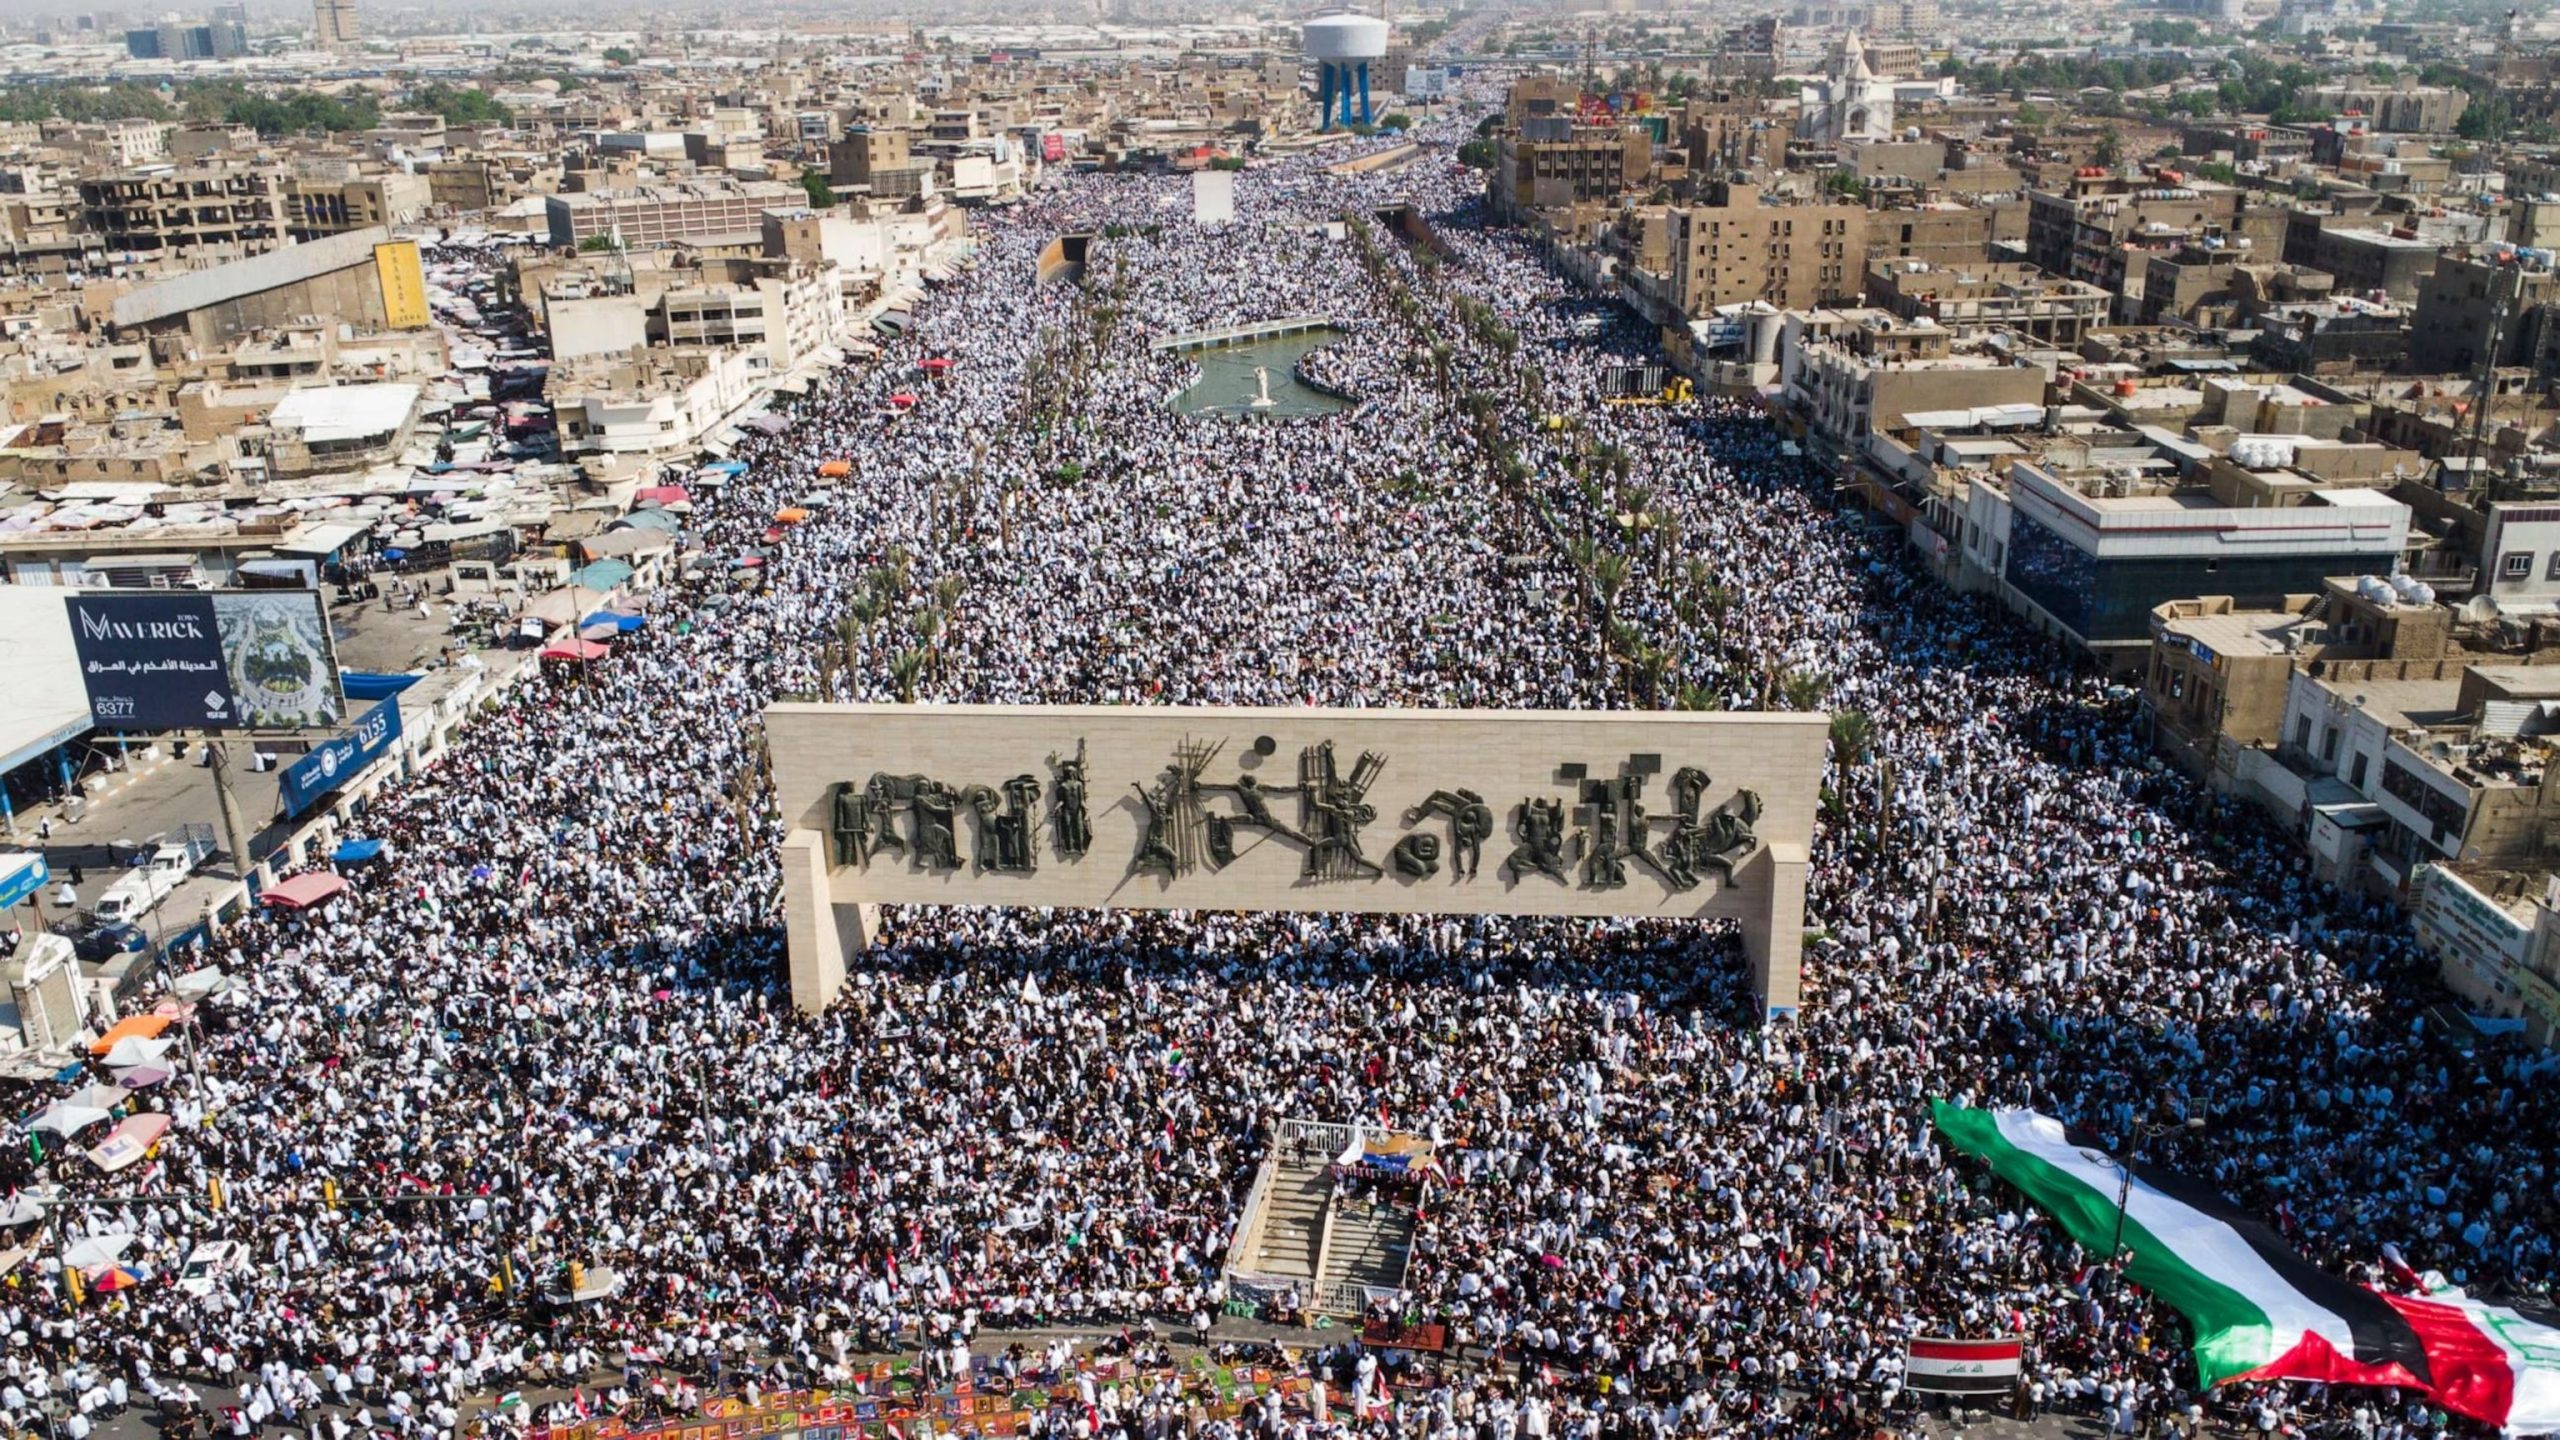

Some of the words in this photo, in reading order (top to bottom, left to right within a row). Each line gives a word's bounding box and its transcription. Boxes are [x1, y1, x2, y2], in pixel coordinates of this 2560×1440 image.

[127, 661, 142, 675] في
[96, 702, 135, 715] 6377
[359, 712, 387, 745] 6155
